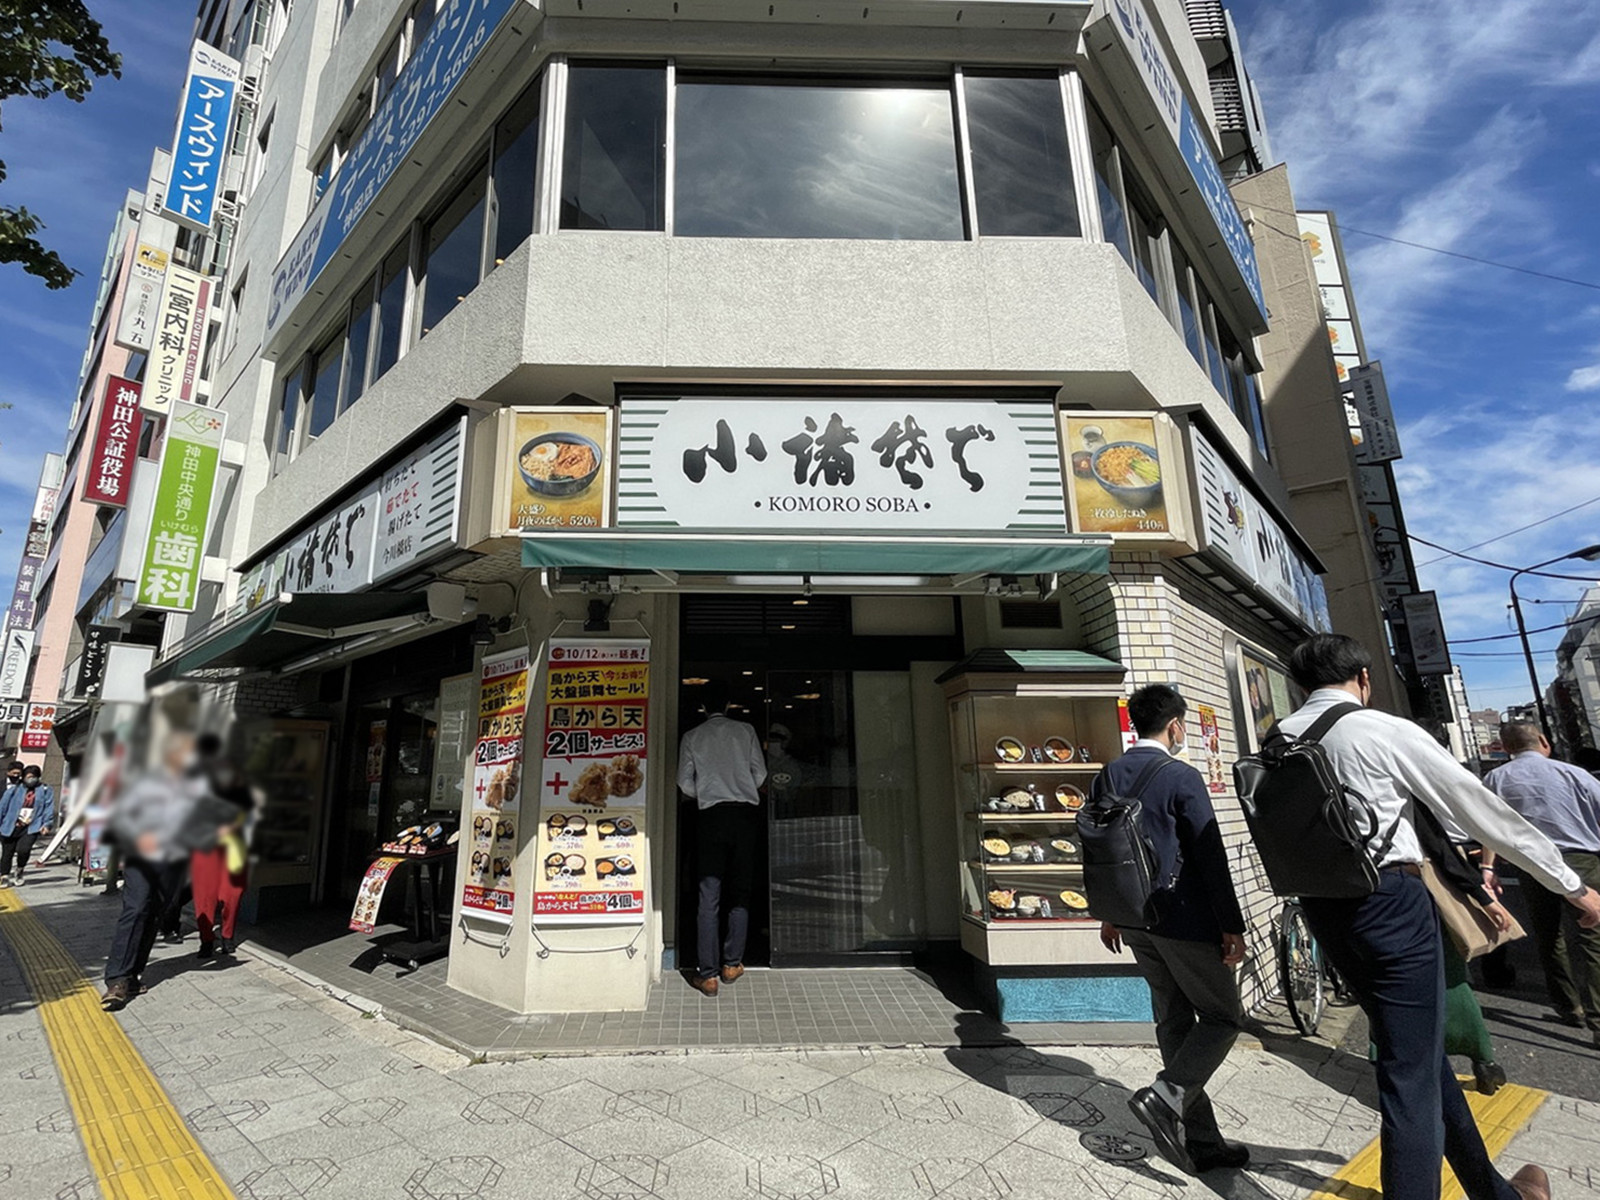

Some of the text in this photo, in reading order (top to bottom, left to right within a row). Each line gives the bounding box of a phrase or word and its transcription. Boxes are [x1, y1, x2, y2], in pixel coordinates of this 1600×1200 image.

[179, 79, 226, 216] アースウィンド
[338, 0, 492, 221] アースウィン
[183, 353, 198, 385] CLINIC
[97, 386, 138, 497] 神田公証役場
[174, 444, 202, 522] 神田中央通り
[768, 496, 919, 512] KOMORO SOBA
[144, 531, 198, 608] 歯科
[550, 707, 643, 727] 鳥から天
